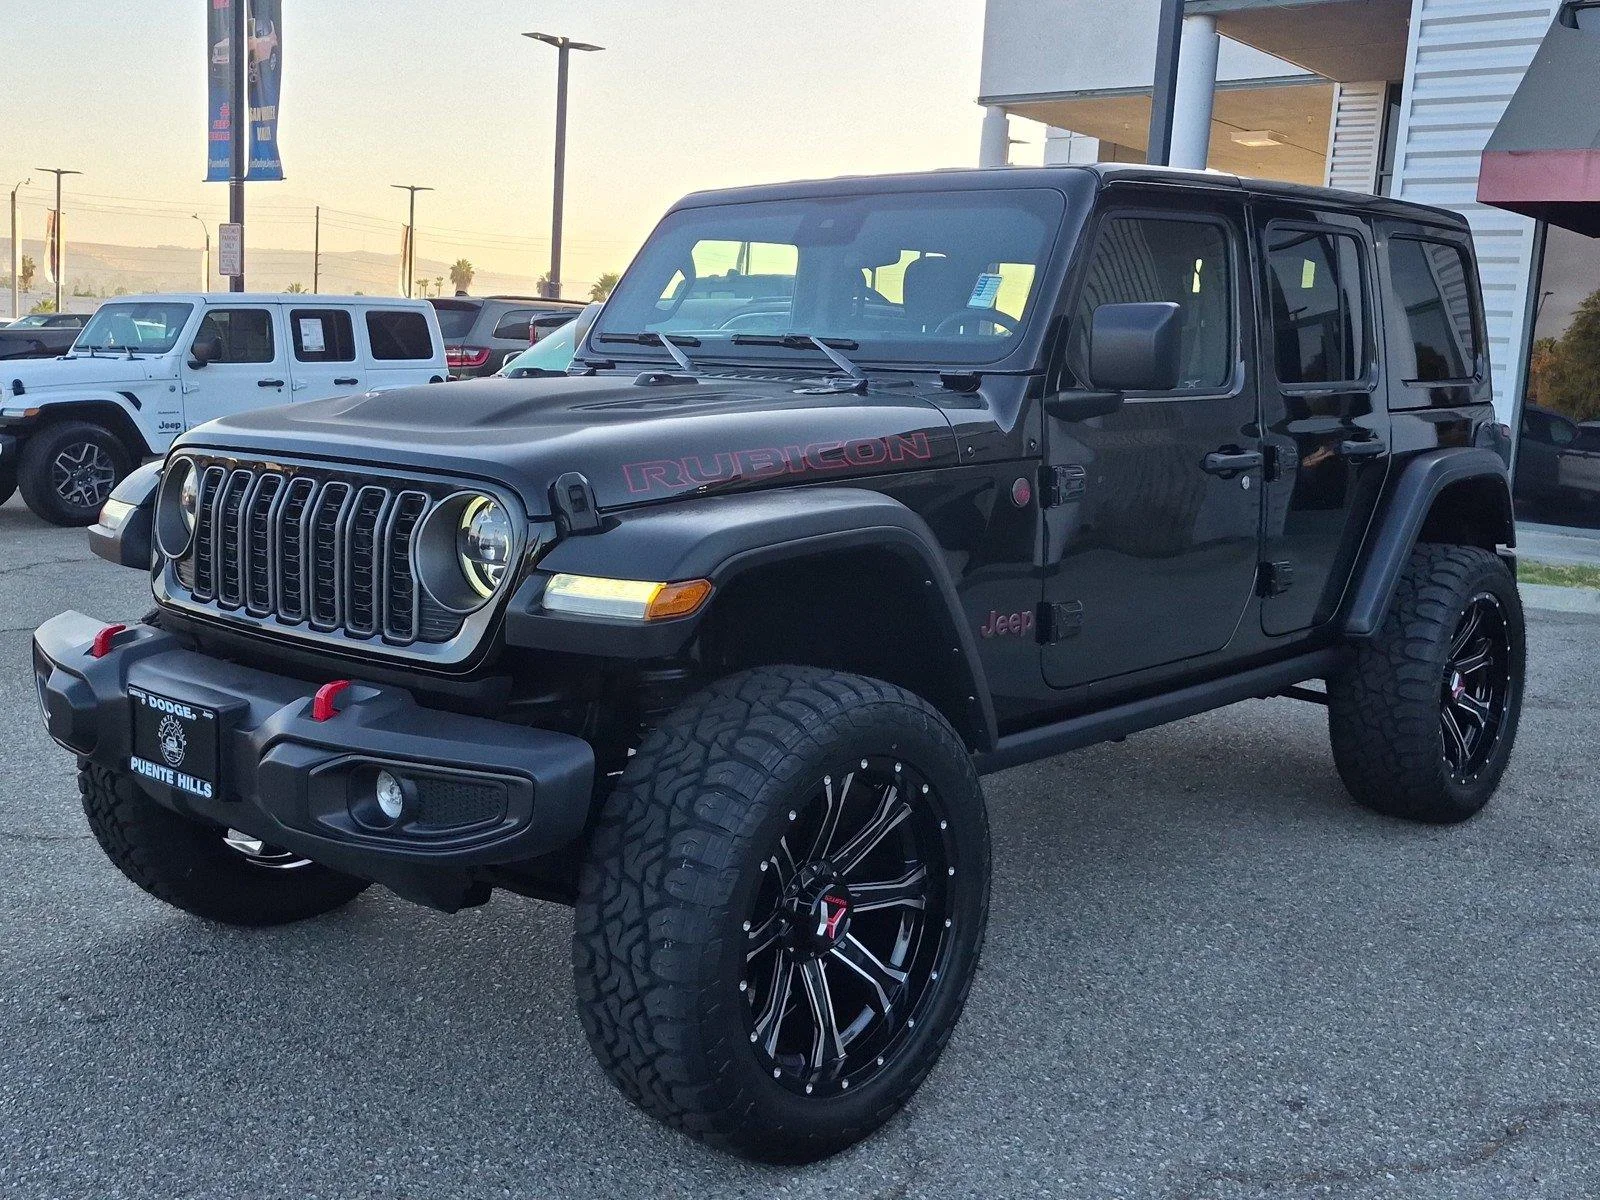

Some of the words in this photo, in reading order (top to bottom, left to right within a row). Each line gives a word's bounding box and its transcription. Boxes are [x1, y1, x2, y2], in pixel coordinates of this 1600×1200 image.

[159, 421, 181, 430] Jeep
[622, 432, 931, 493] RUBICON
[981, 610, 1034, 639] Jeep
[148, 695, 192, 720] DODGE
[130, 756, 174, 785] PUENTE
[177, 773, 213, 798] HILLS
